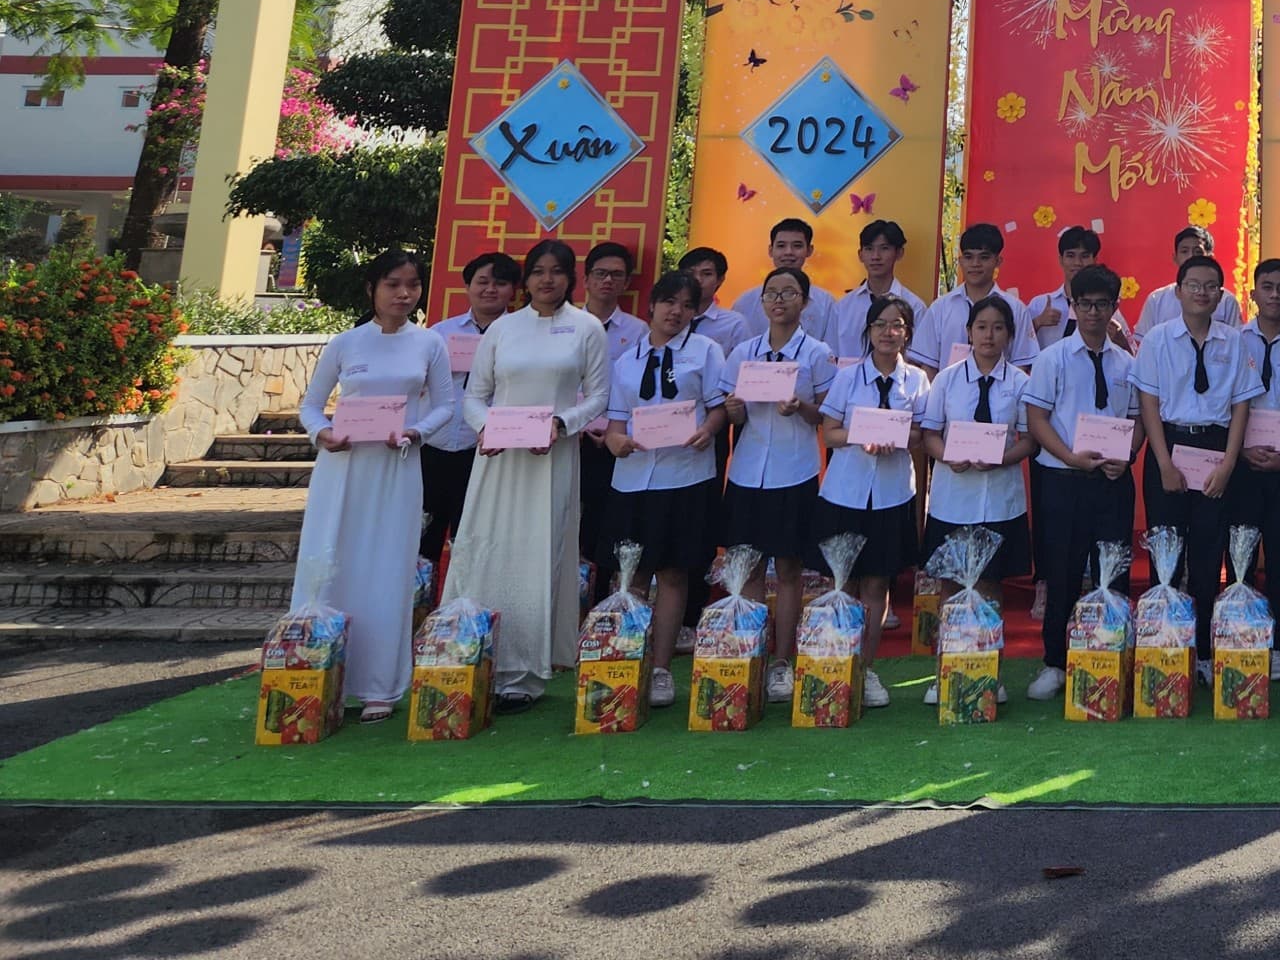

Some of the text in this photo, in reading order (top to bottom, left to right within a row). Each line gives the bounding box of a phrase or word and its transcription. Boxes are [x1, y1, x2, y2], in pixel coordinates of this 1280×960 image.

[1057, 65, 1160, 122] Năm
[499, 119, 620, 171] Xuân
[767, 113, 876, 160] 2024
[1073, 141, 1161, 203] Mới
